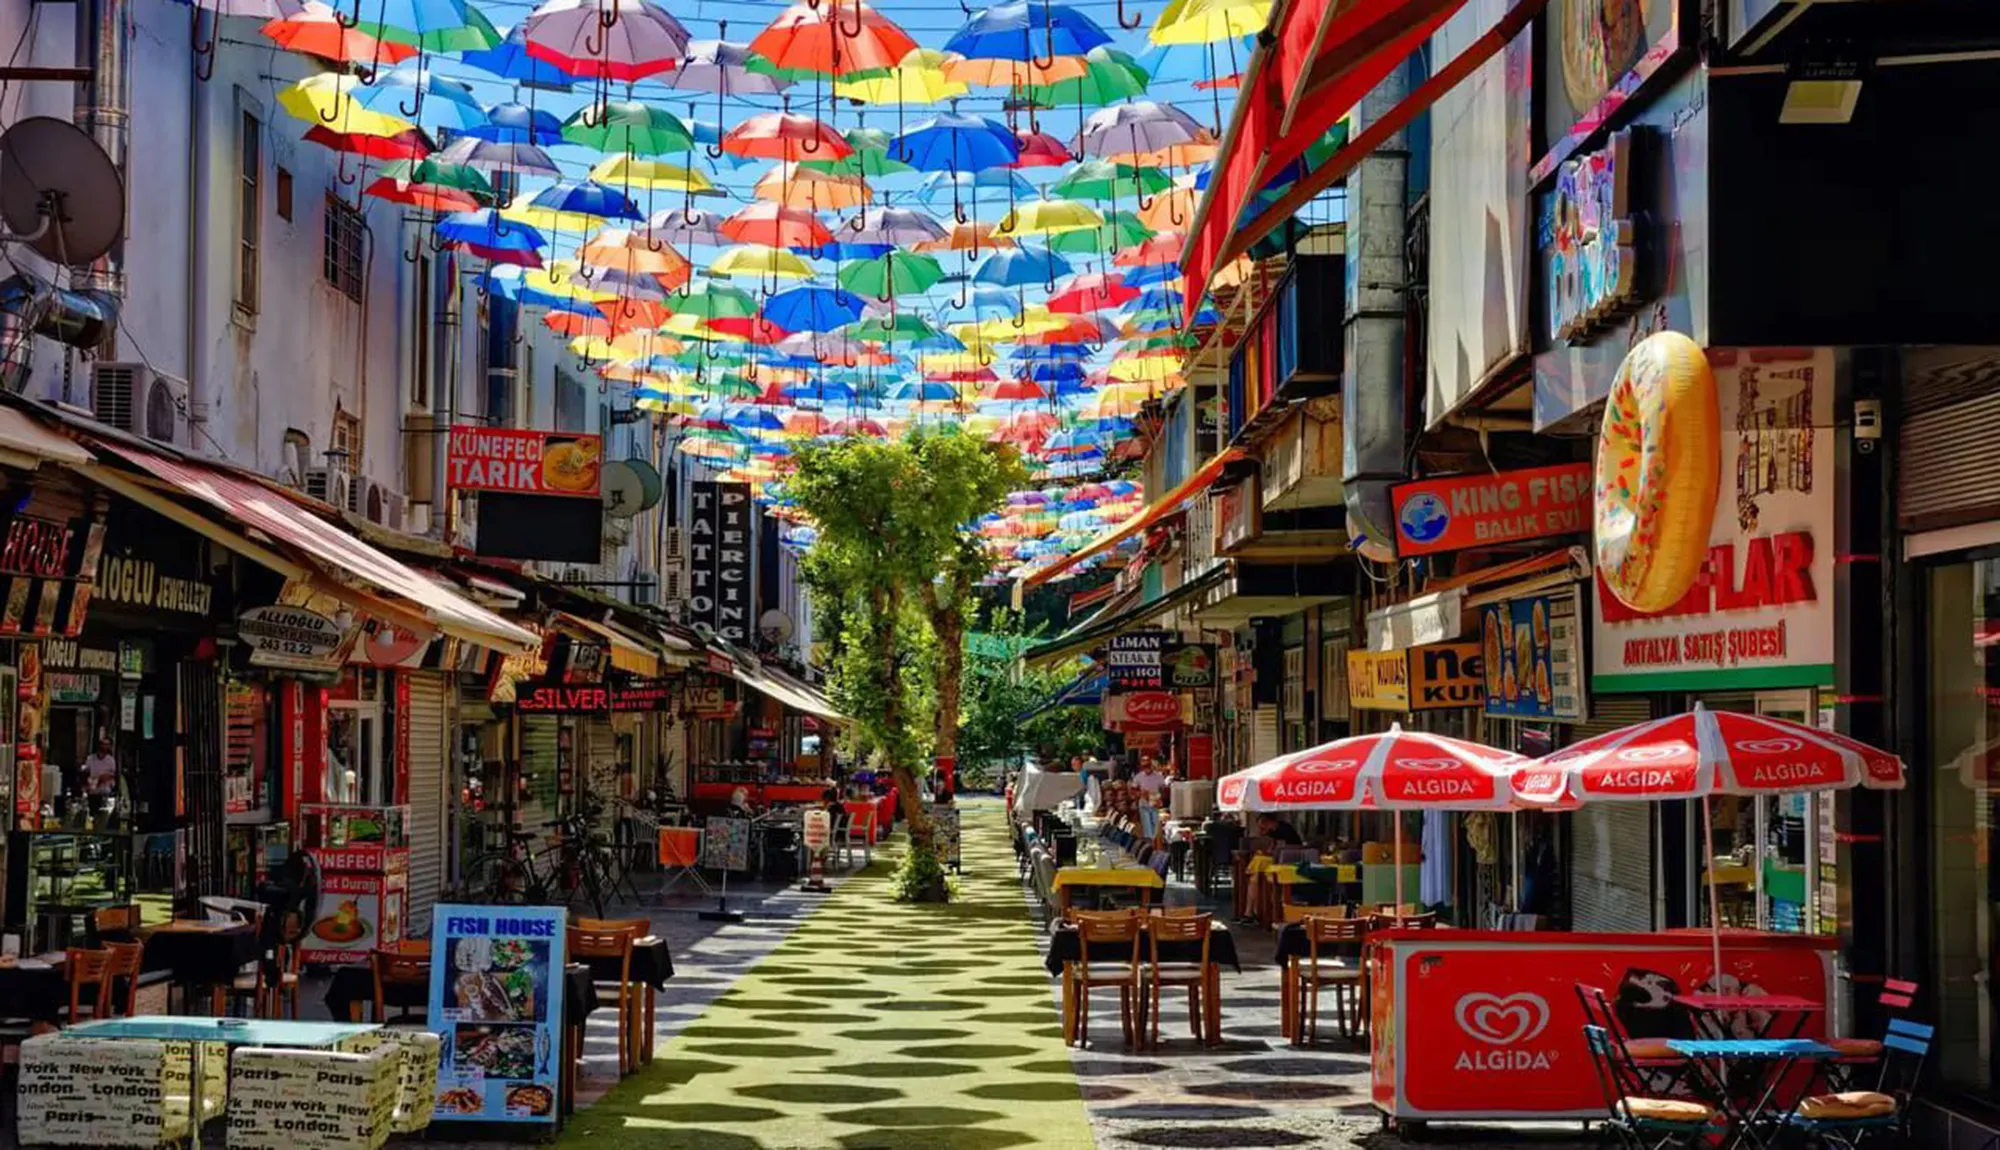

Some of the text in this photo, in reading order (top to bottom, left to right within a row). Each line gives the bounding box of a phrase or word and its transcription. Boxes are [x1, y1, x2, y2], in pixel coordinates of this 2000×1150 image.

[452, 428, 543, 461] KÜNEFECİ
[451, 457, 538, 490] TARIK
[1449, 481, 1520, 517] KING
[690, 492, 714, 633] TATTOO
[719, 492, 745, 639] PIERCING
[156, 576, 212, 616] JEWELLERY
[260, 638, 313, 655] 243 12 22
[1623, 619, 1787, 666] ANTALYA SATIŞ ŞUBESİ
[532, 687, 608, 710] SILVER
[687, 688, 718, 704] WC
[446, 916, 557, 938] FISH HOUSE
[24, 1062, 146, 1078] York New York
[233, 1066, 364, 1086] Paris Paris
[91, 1082, 161, 1097] London
[45, 1111, 94, 1123] Paris
[252, 1098, 287, 1110] New
[291, 1100, 327, 1114] York
[337, 1103, 371, 1117] New
[274, 1118, 340, 1133] London
